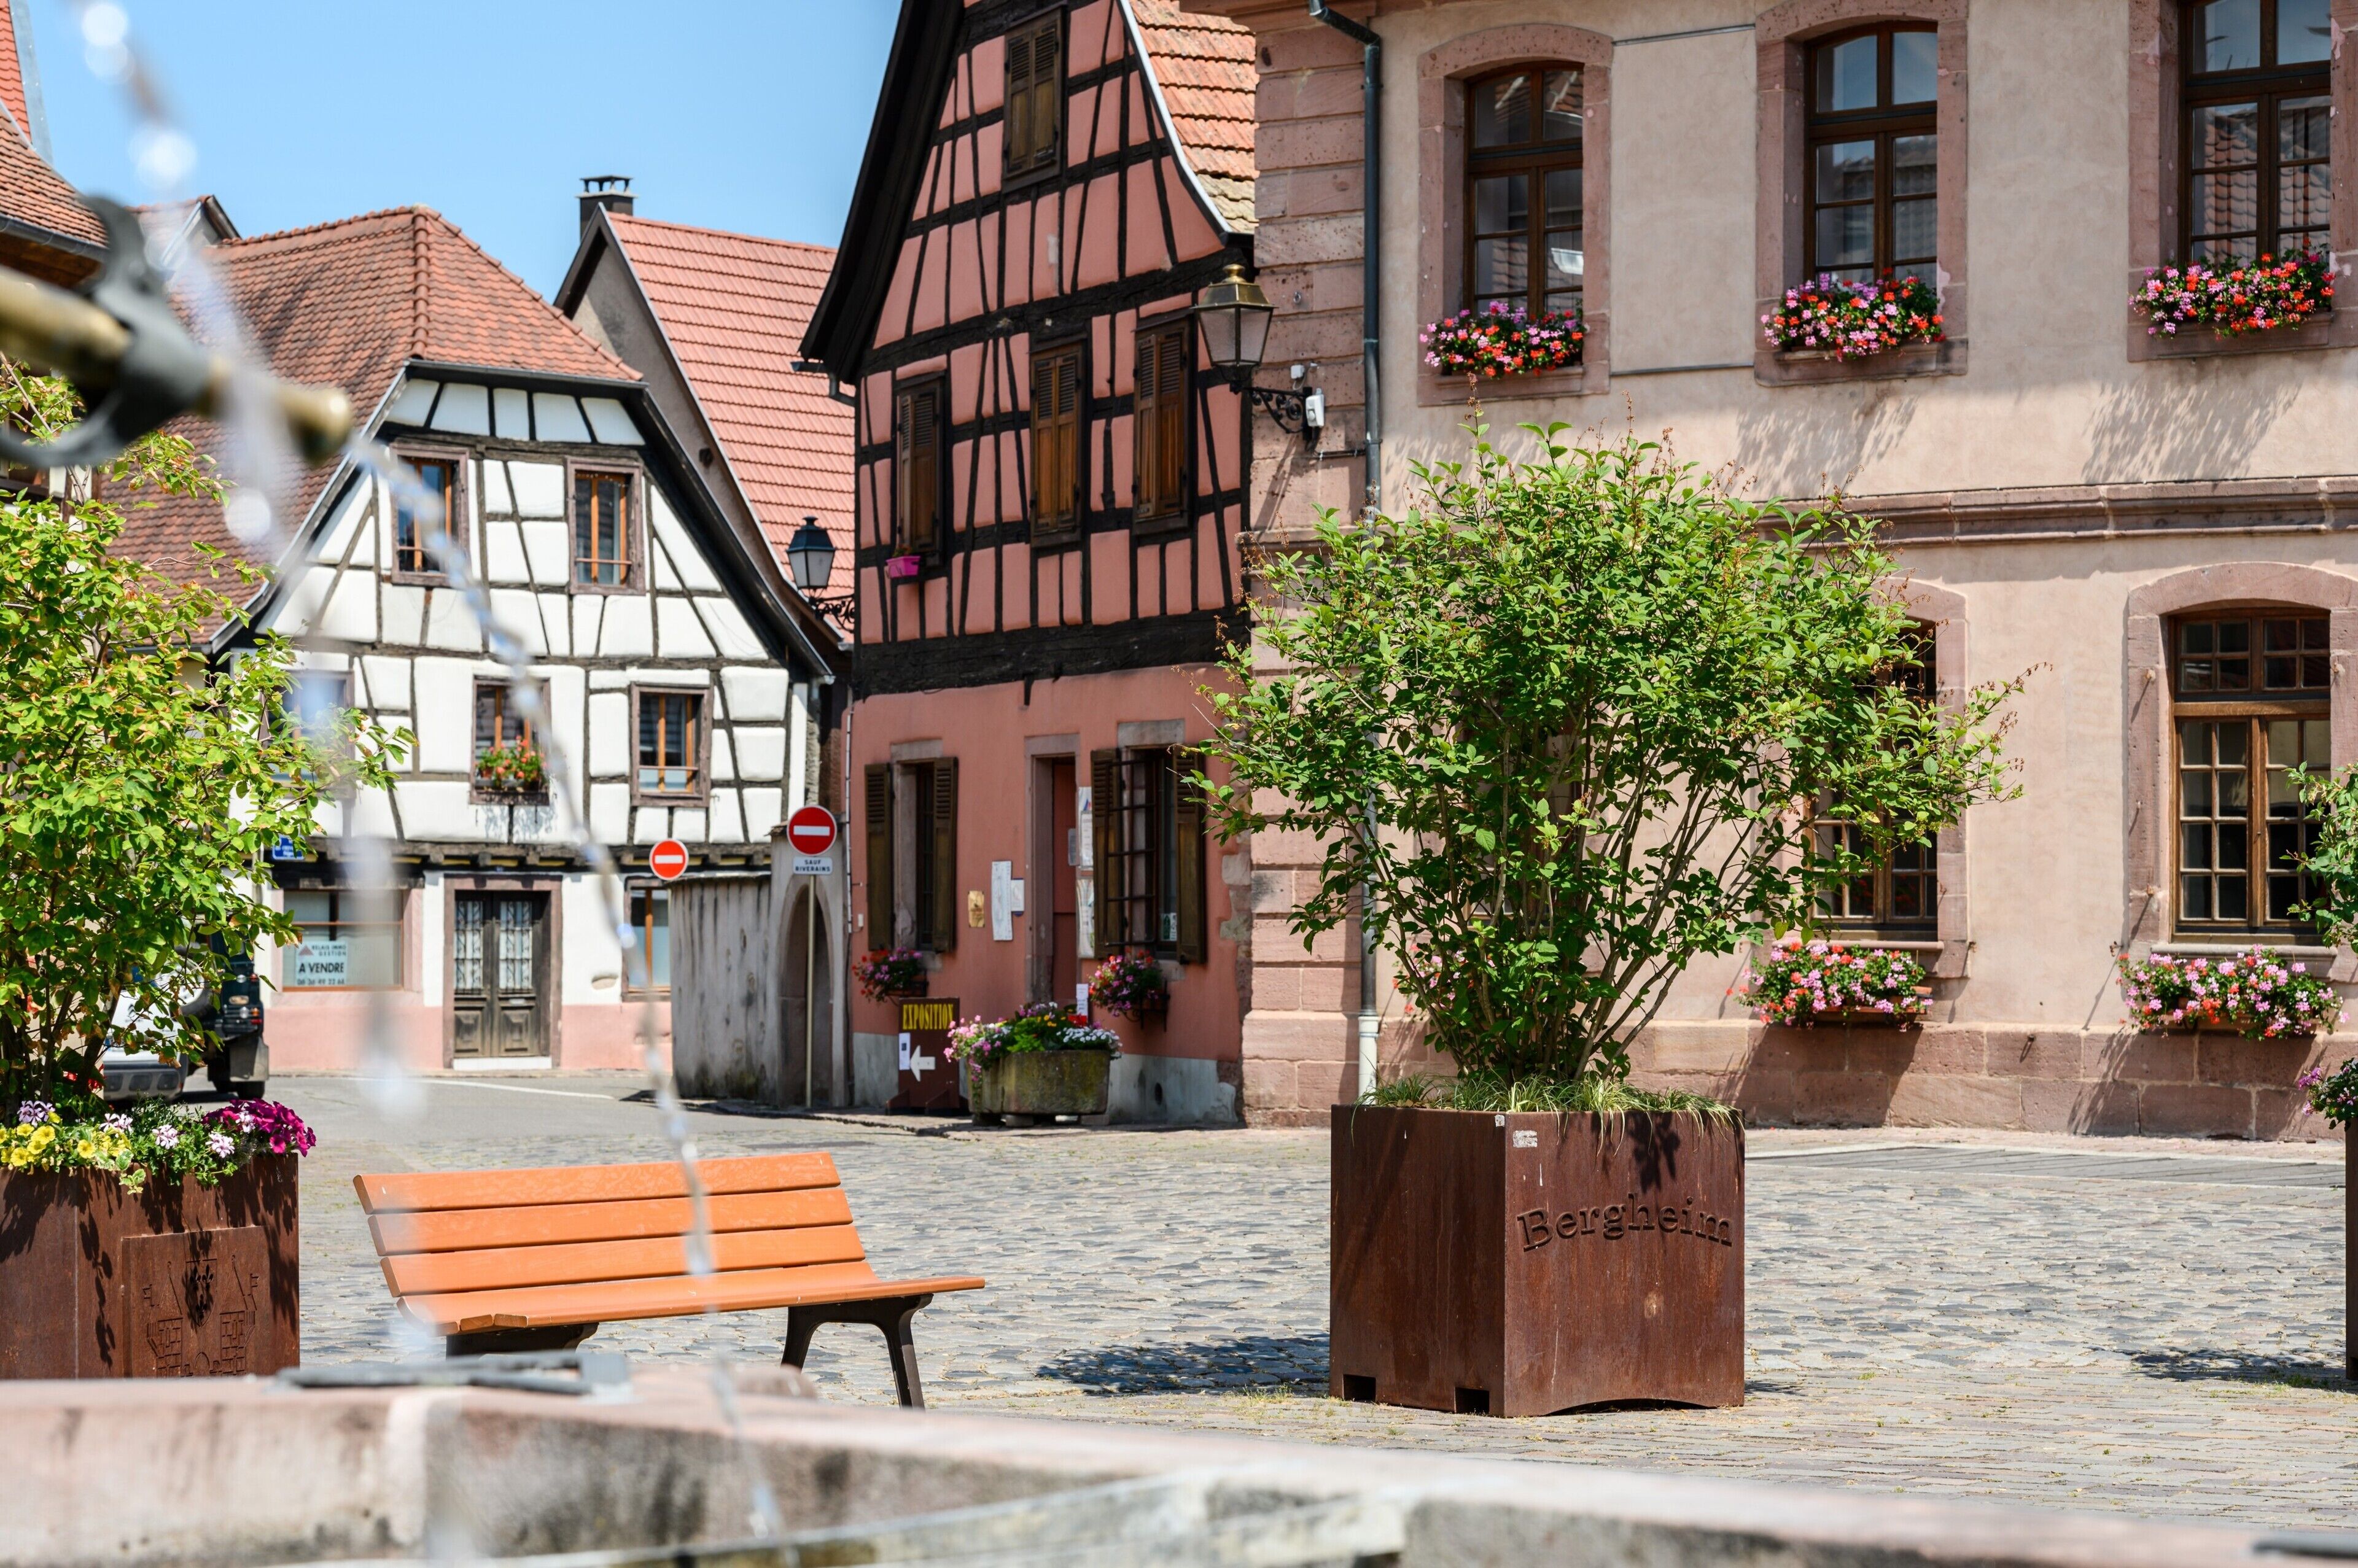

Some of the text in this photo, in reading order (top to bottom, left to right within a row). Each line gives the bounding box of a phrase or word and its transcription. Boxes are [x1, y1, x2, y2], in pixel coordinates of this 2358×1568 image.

[298, 963, 344, 973] A VENDRE
[903, 1004, 953, 1030] EXPOSITION
[1517, 1192, 1732, 1252] Bergheim
